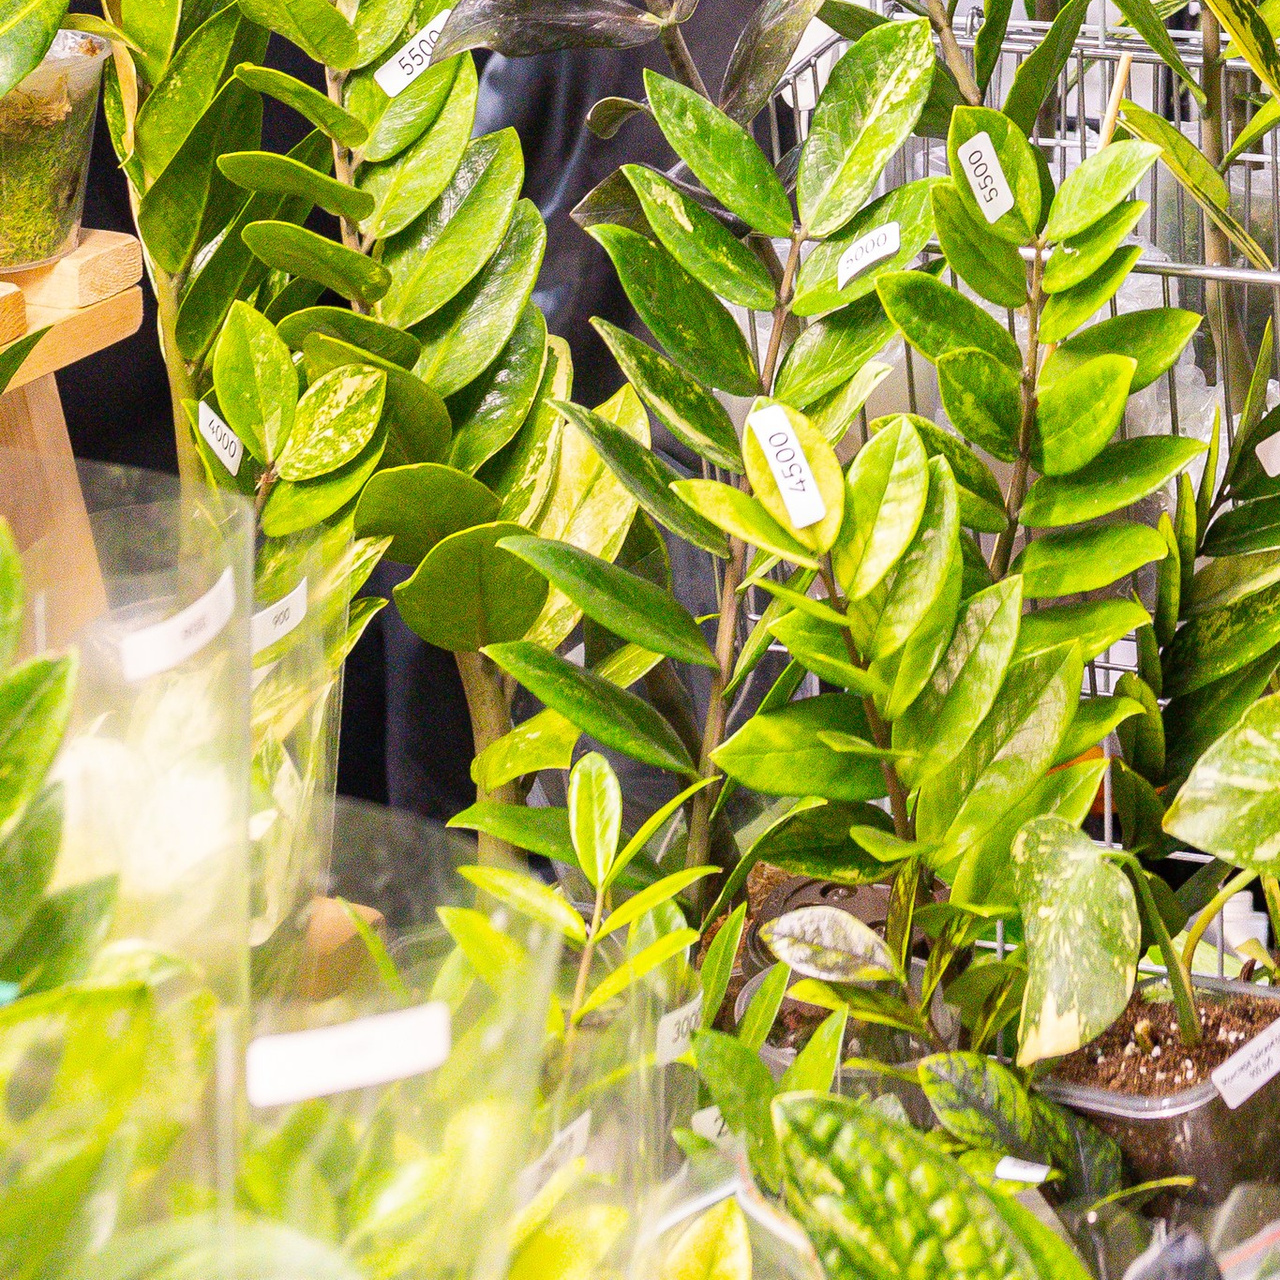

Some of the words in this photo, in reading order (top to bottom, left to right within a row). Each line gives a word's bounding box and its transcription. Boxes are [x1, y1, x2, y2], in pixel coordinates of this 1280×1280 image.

[398, 29, 441, 76] 5500
[967, 149, 999, 204] 5500
[207, 417, 237, 459] 4000
[768, 431, 806, 493] 4500
